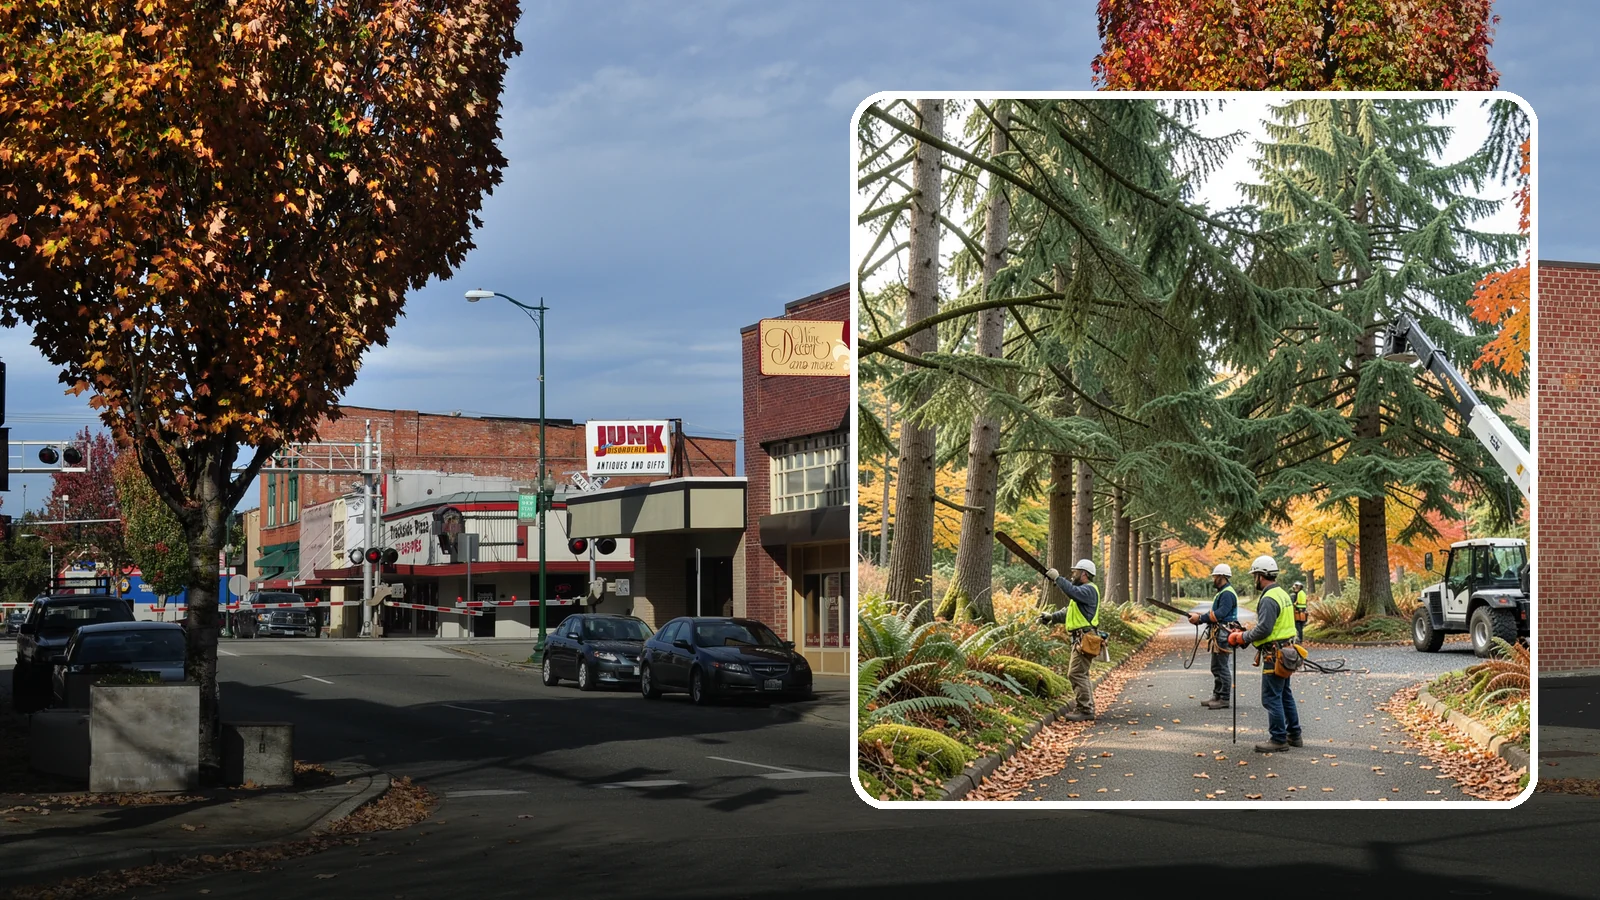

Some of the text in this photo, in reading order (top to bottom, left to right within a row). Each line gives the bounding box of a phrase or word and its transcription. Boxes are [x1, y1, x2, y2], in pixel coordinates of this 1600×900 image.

[791, 325, 823, 345] Wine
[596, 425, 665, 457] JUNK
[597, 460, 665, 470] ANTIQUES AND GIFTS
[390, 519, 429, 540] Trackside Pizza
